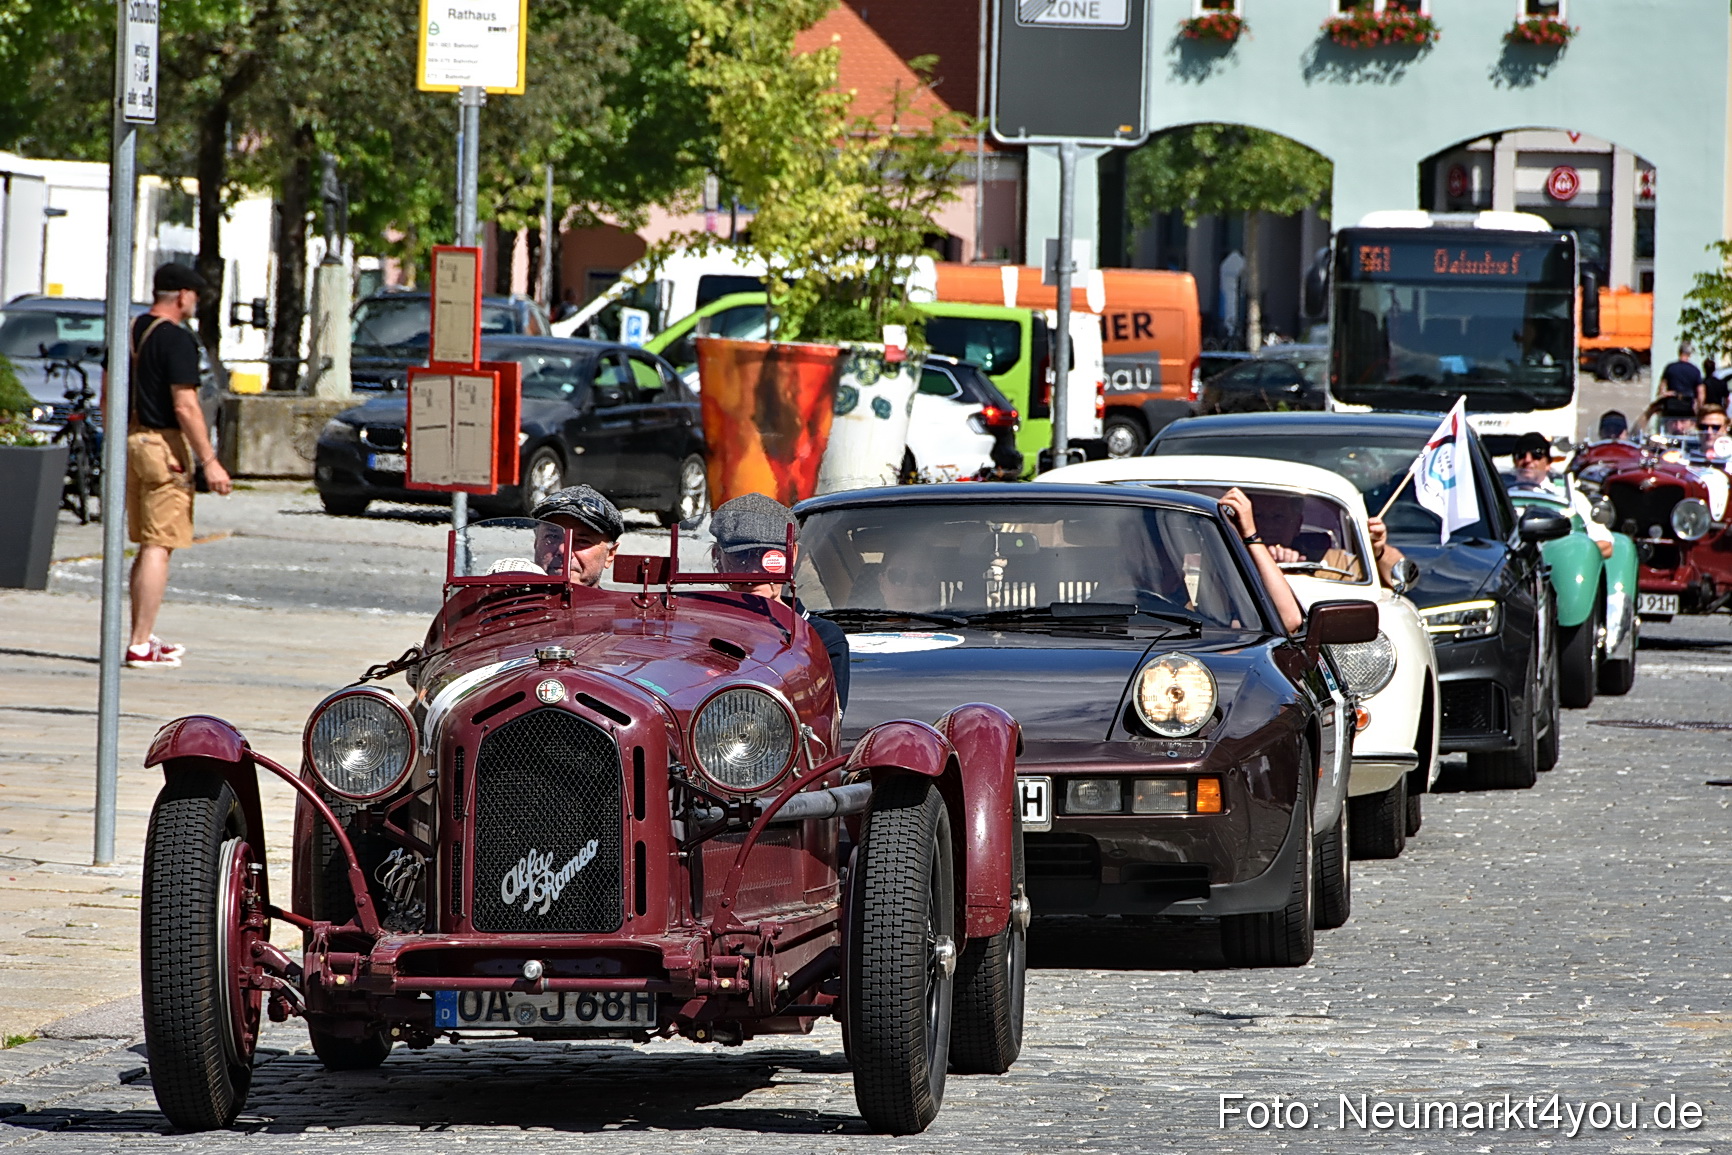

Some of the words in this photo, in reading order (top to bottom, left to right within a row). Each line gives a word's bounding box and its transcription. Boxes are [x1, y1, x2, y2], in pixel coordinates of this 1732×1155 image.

[448, 8, 496, 21] Rathaus
[1045, 0, 1100, 19] ZONE
[501, 848, 554, 912] Alfa
[532, 839, 599, 916] Romeo
[458, 991, 511, 1022] OA
[575, 991, 654, 1022] 68H
